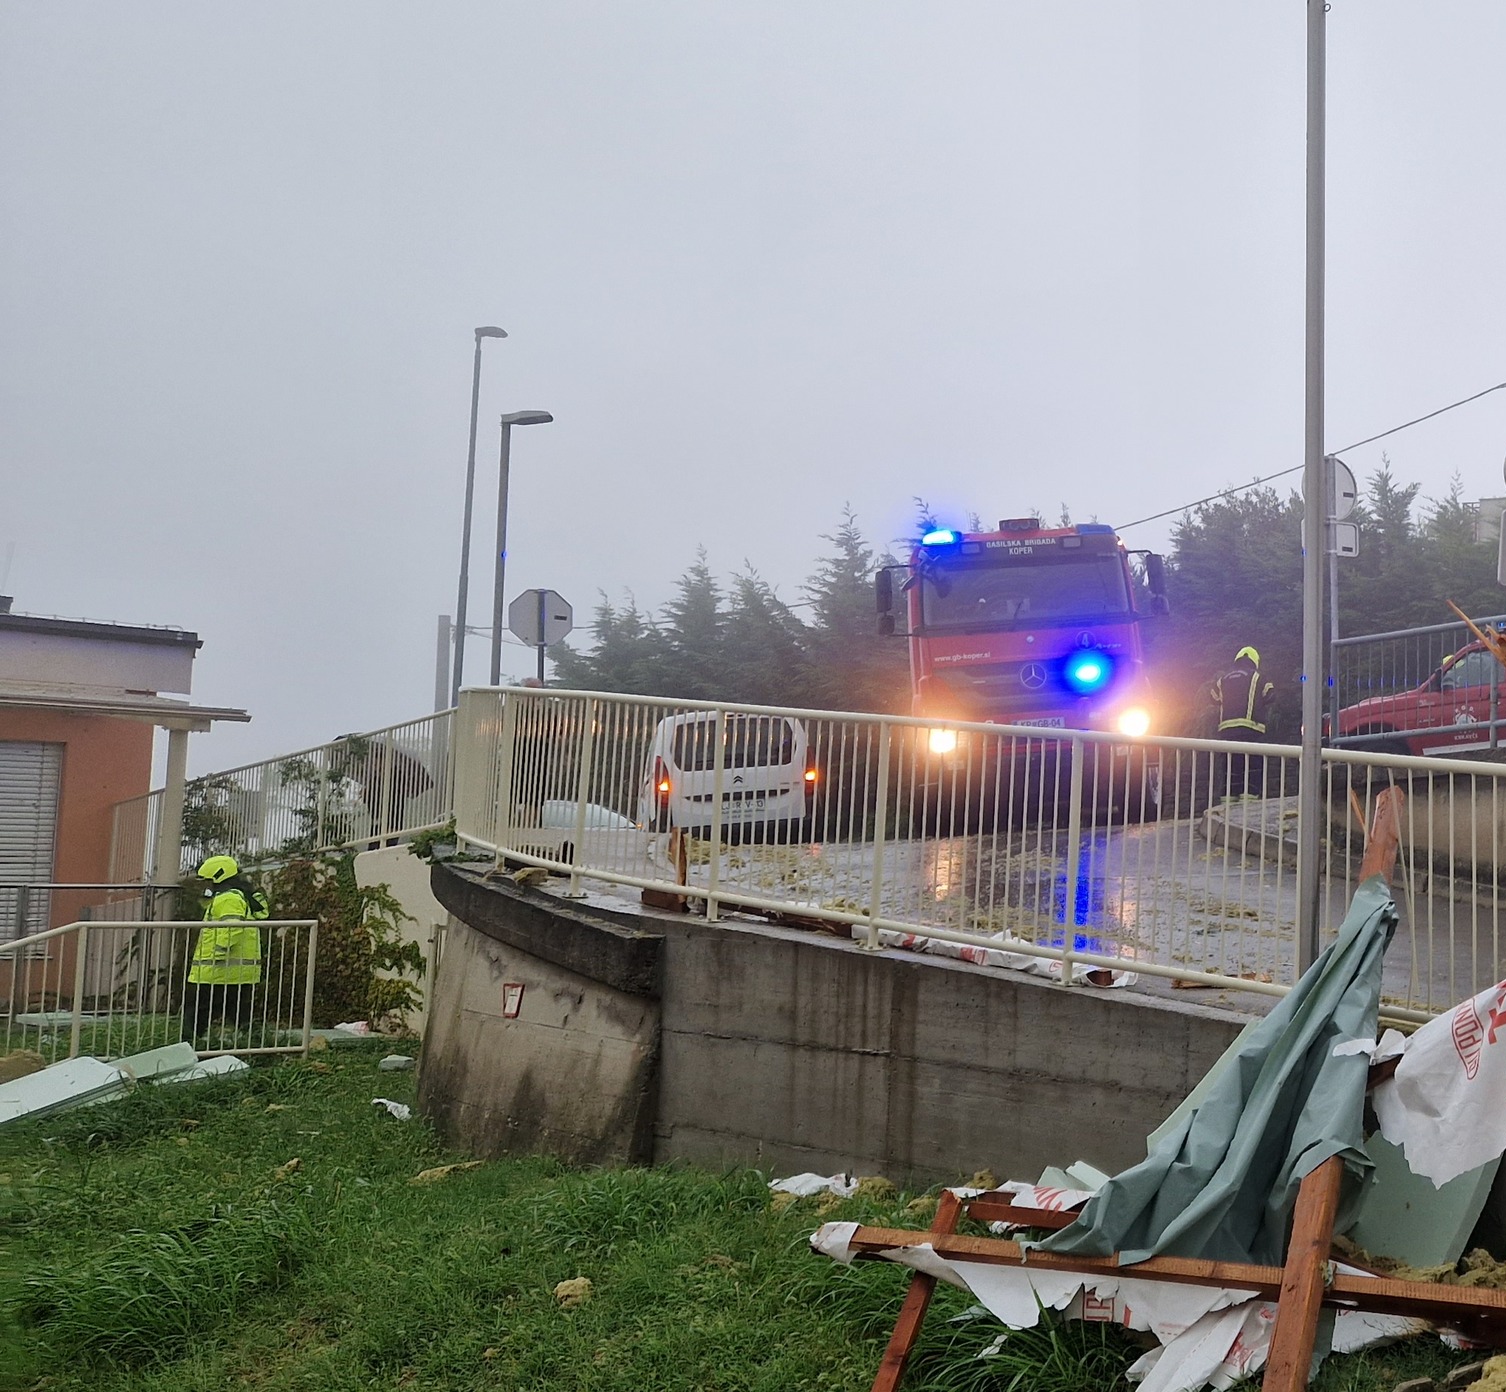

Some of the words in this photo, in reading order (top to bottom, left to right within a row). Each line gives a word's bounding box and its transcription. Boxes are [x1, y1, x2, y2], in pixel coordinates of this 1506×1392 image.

[986, 540, 1021, 548] GASILSKA
[1024, 538, 1056, 546] BRIGADA
[1009, 546, 1033, 555] KOPER
